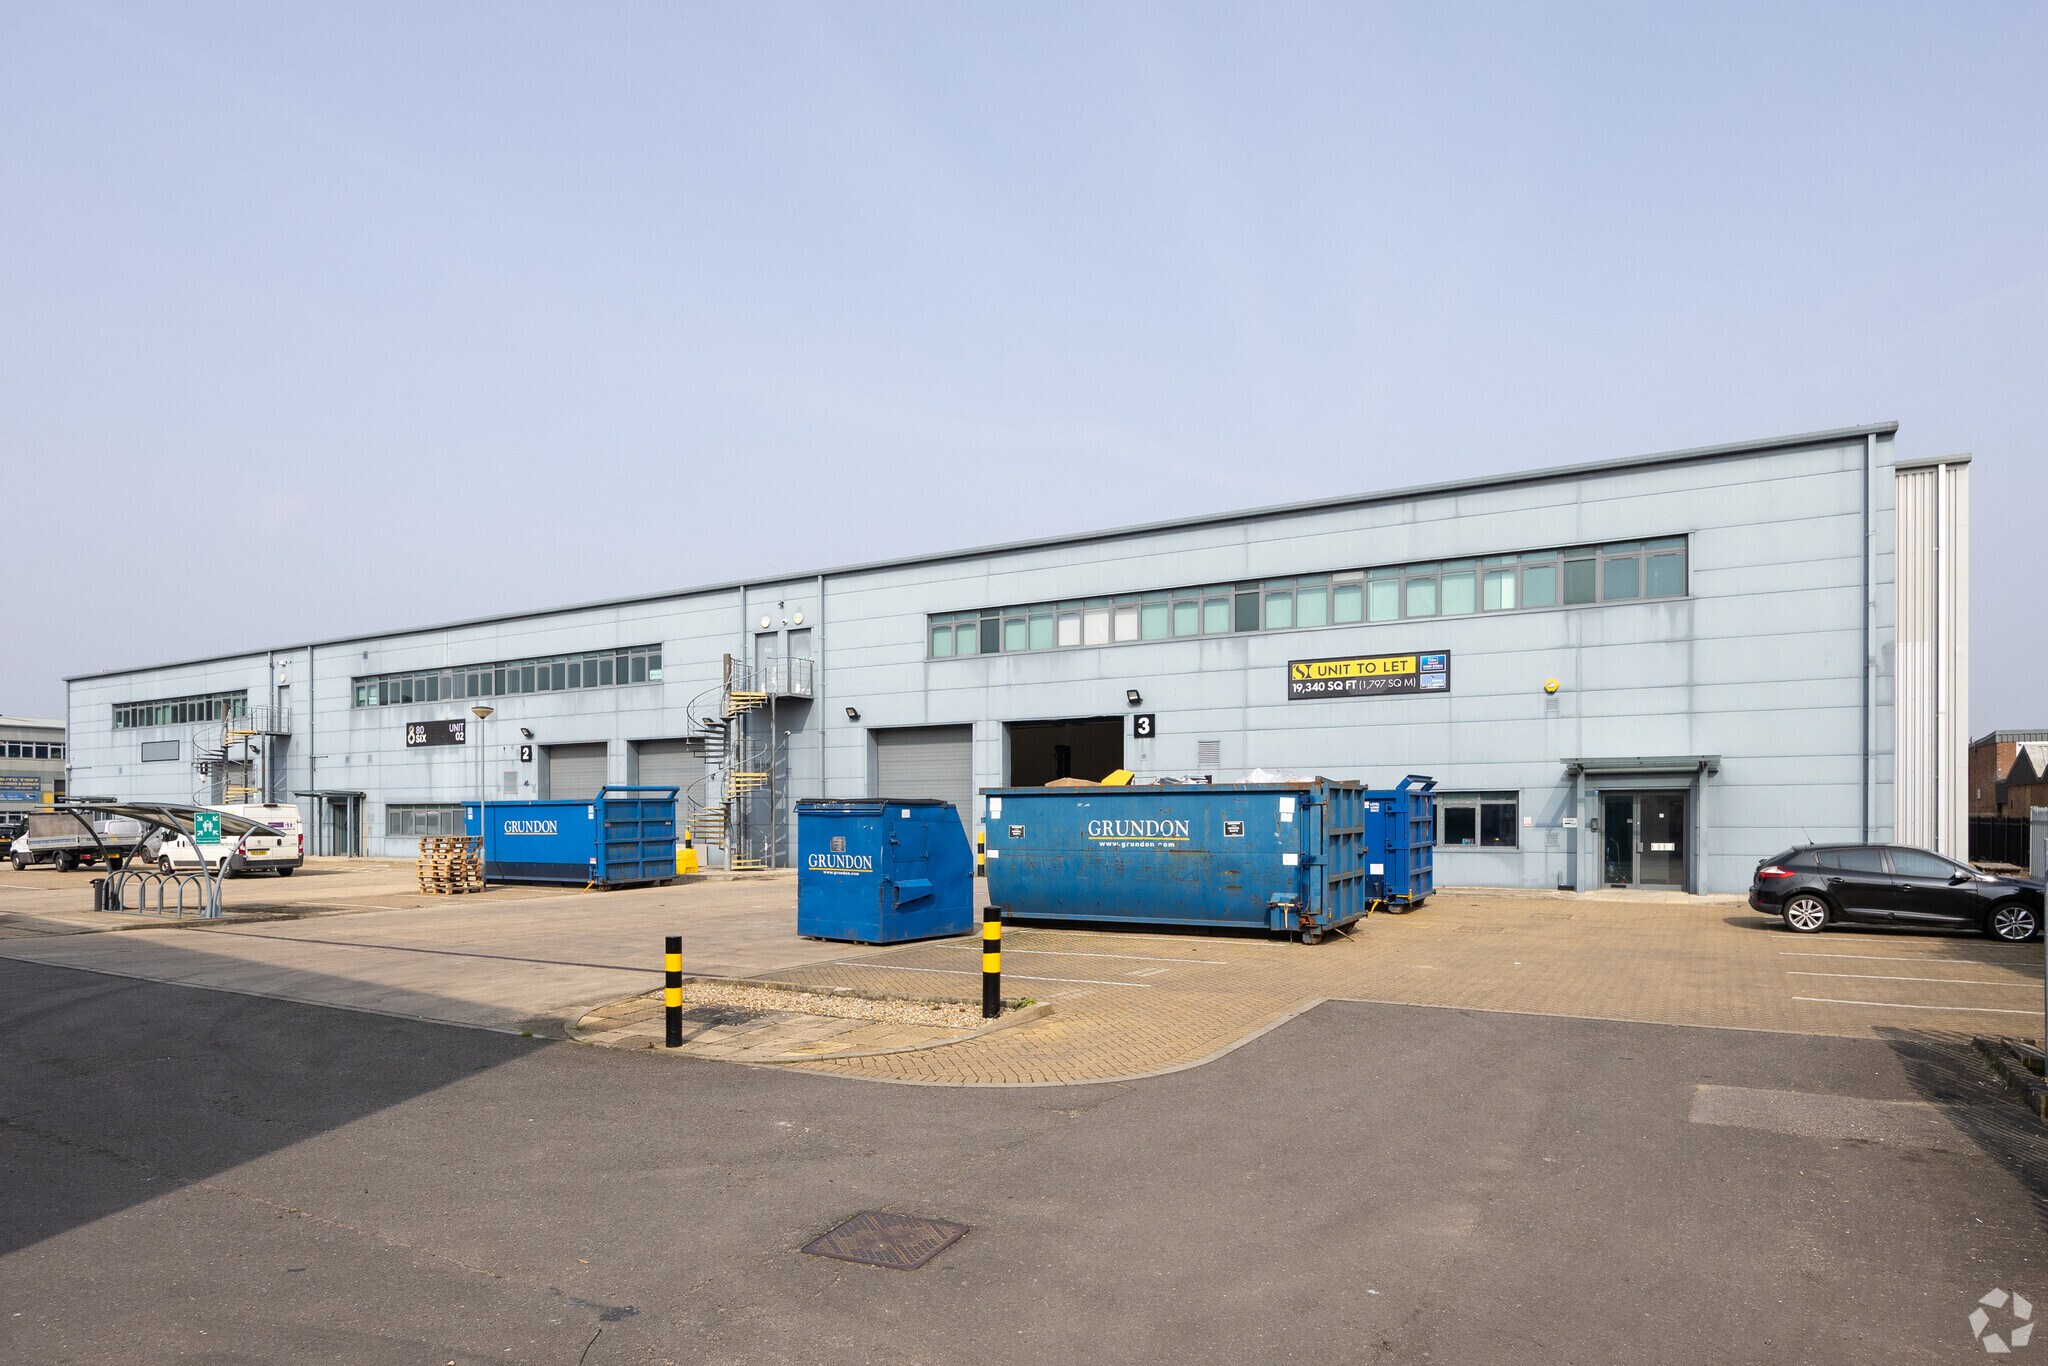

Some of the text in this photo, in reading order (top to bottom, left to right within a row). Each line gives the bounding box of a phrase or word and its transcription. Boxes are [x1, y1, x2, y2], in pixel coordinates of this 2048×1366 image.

[1318, 664, 1350, 676] UNIT
[1357, 663, 1376, 673] TO
[1383, 661, 1408, 672] LET
[1292, 682, 1325, 694] 19,340
[1327, 681, 1343, 691] SQ
[1346, 680, 1357, 690] FT
[1359, 680, 1386, 690] (1,797
[1388, 679, 1402, 688] SQ
[1404, 678, 1416, 687] M)
[448, 723, 464, 732] UNIT
[1138, 717, 1150, 734] 3
[415, 734, 427, 743] SIX
[455, 732, 464, 741] 02
[522, 747, 530, 760] 2
[504, 820, 558, 833] GRUNDON
[1088, 820, 1190, 837] GRUNDON
[808, 853, 873, 869] GRUNDON
